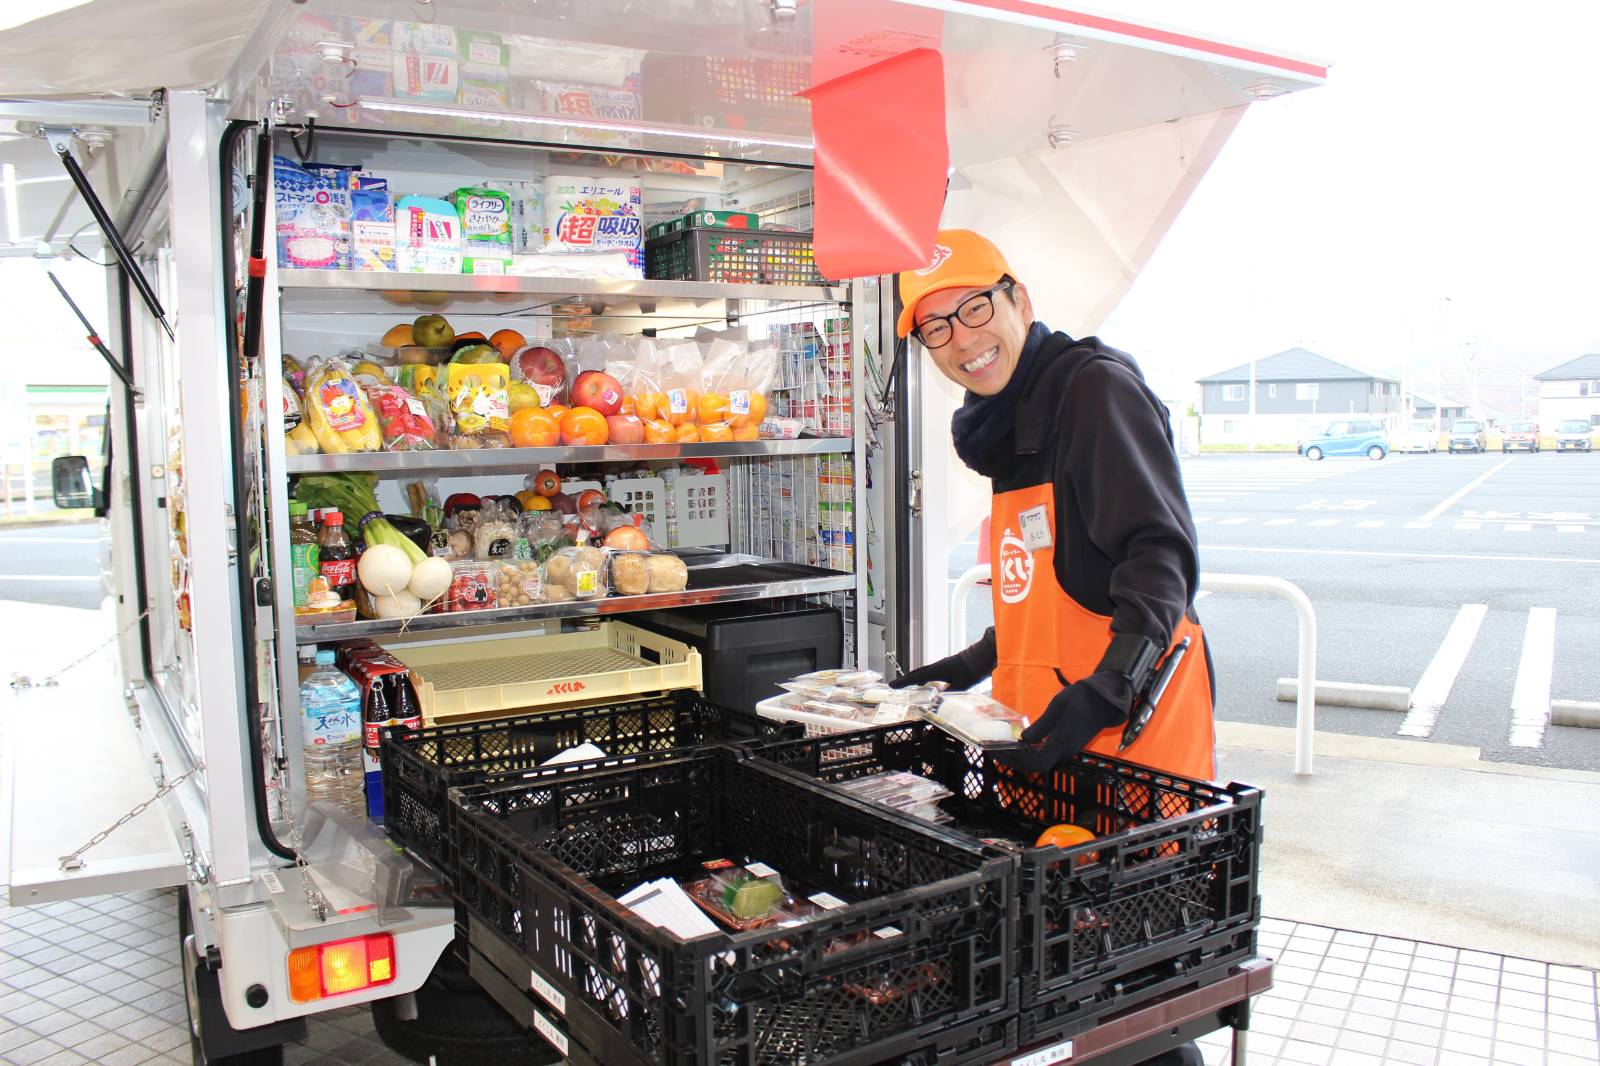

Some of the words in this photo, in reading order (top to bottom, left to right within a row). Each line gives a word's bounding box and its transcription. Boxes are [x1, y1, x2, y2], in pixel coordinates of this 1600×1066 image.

[580, 186, 624, 196] エリエール
[471, 200, 501, 210] ライフリー
[559, 215, 640, 245] 超吸収
[314, 712, 356, 731] 天然水
